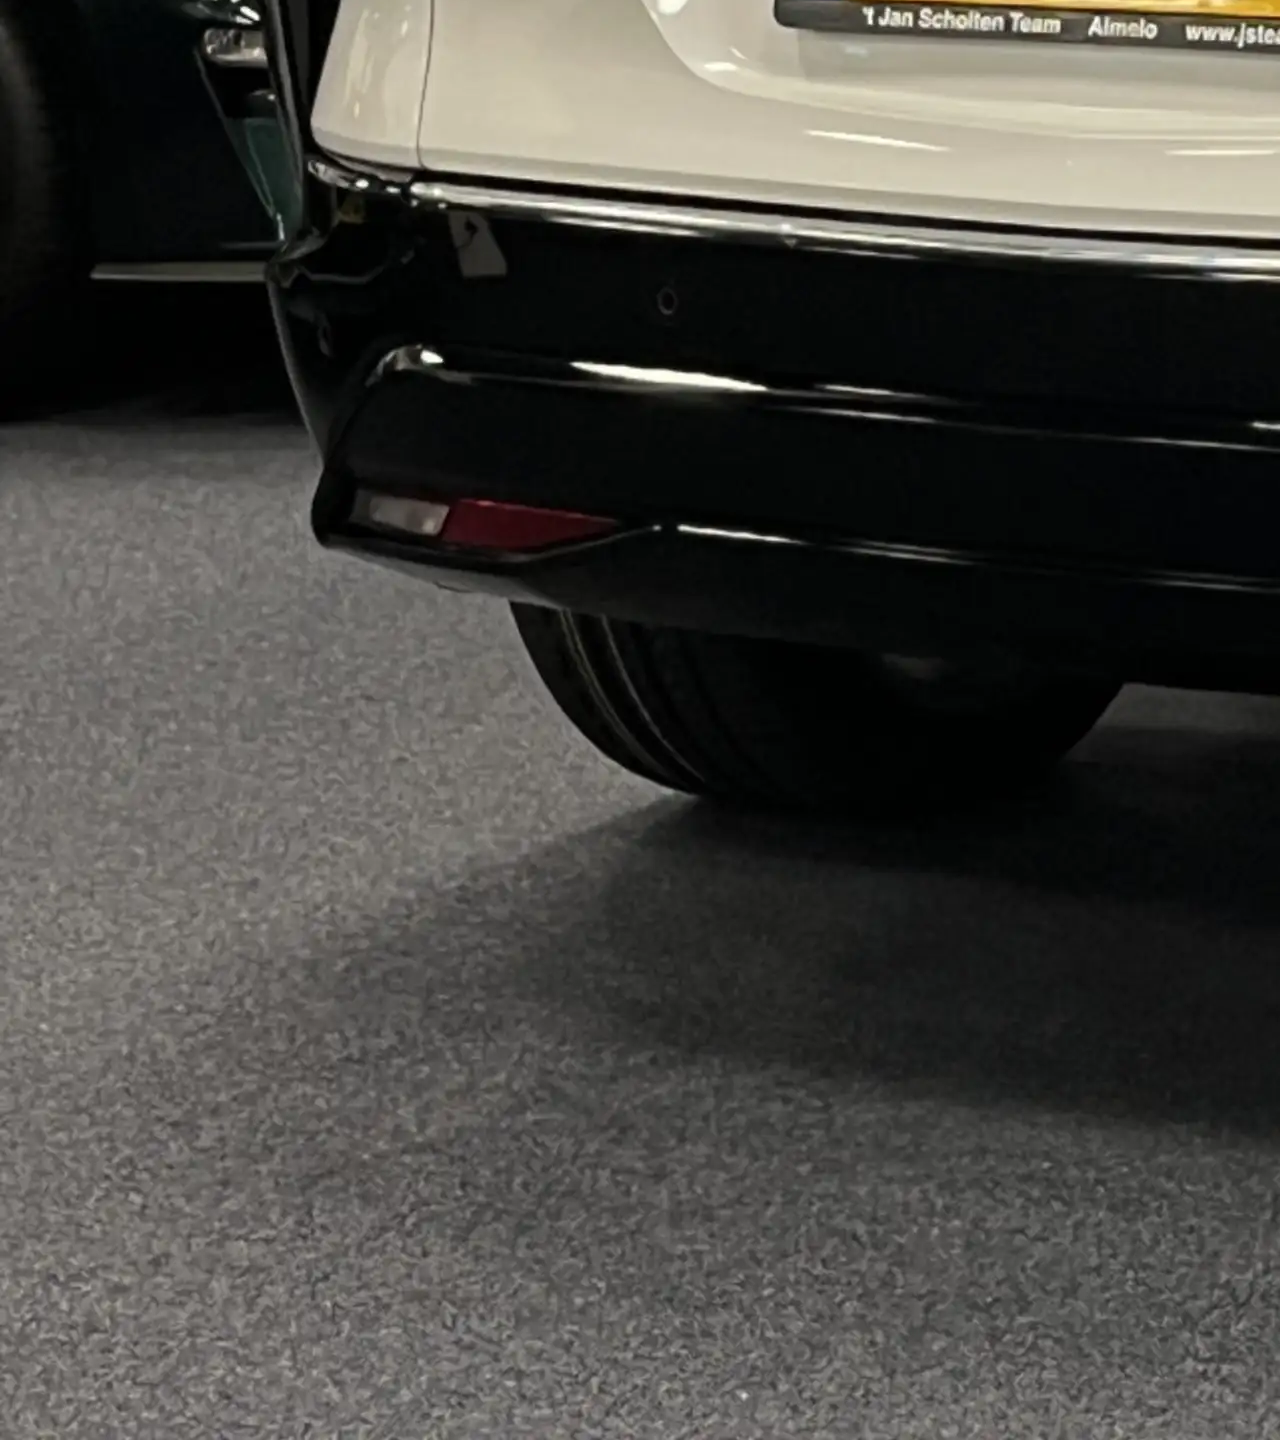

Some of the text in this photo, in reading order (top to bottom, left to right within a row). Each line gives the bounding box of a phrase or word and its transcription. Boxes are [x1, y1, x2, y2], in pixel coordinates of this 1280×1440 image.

[876, 8, 914, 28] Jan
[918, 7, 1005, 32] Scholten
[1011, 12, 1062, 34] Team
[1088, 16, 1159, 39] Almelo
